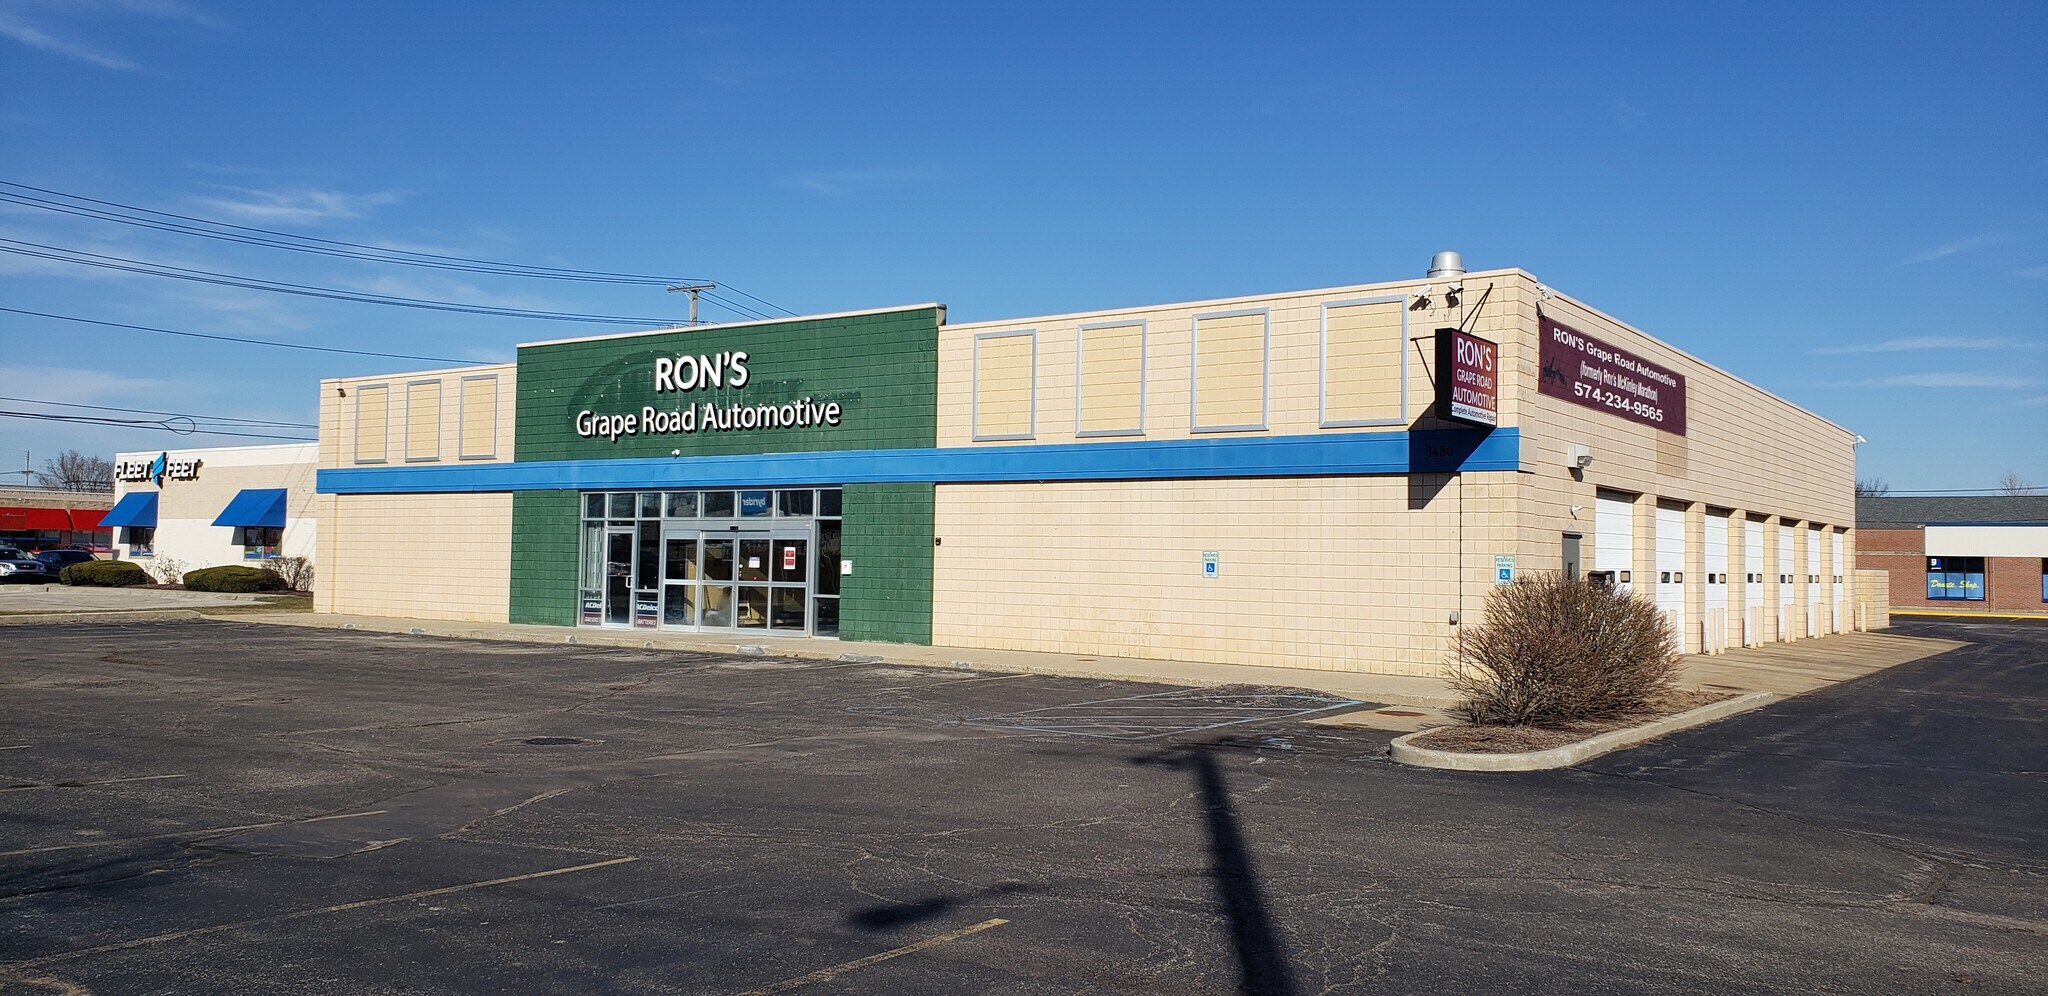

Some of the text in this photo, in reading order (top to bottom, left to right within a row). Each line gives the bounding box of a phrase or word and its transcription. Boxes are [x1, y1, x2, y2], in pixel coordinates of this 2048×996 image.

[655, 351, 749, 391] RON'S
[1457, 337, 1492, 371] RON'S
[1553, 327, 1676, 388] RON'S Grape Road Automotive
[1456, 368, 1493, 390] GRAPE ROAD
[1580, 360, 1603, 385] (formerly
[1617, 374, 1638, 397] McKinley
[1637, 382, 1658, 405] Marathon)
[1452, 386, 1496, 410] AUTOMOTIVE
[1574, 381, 1663, 422] 574-234-9565
[576, 397, 840, 442] Grape Road Automotive
[114, 459, 200, 479] FLEET FEET
[1424, 444, 1454, 457] 3430
